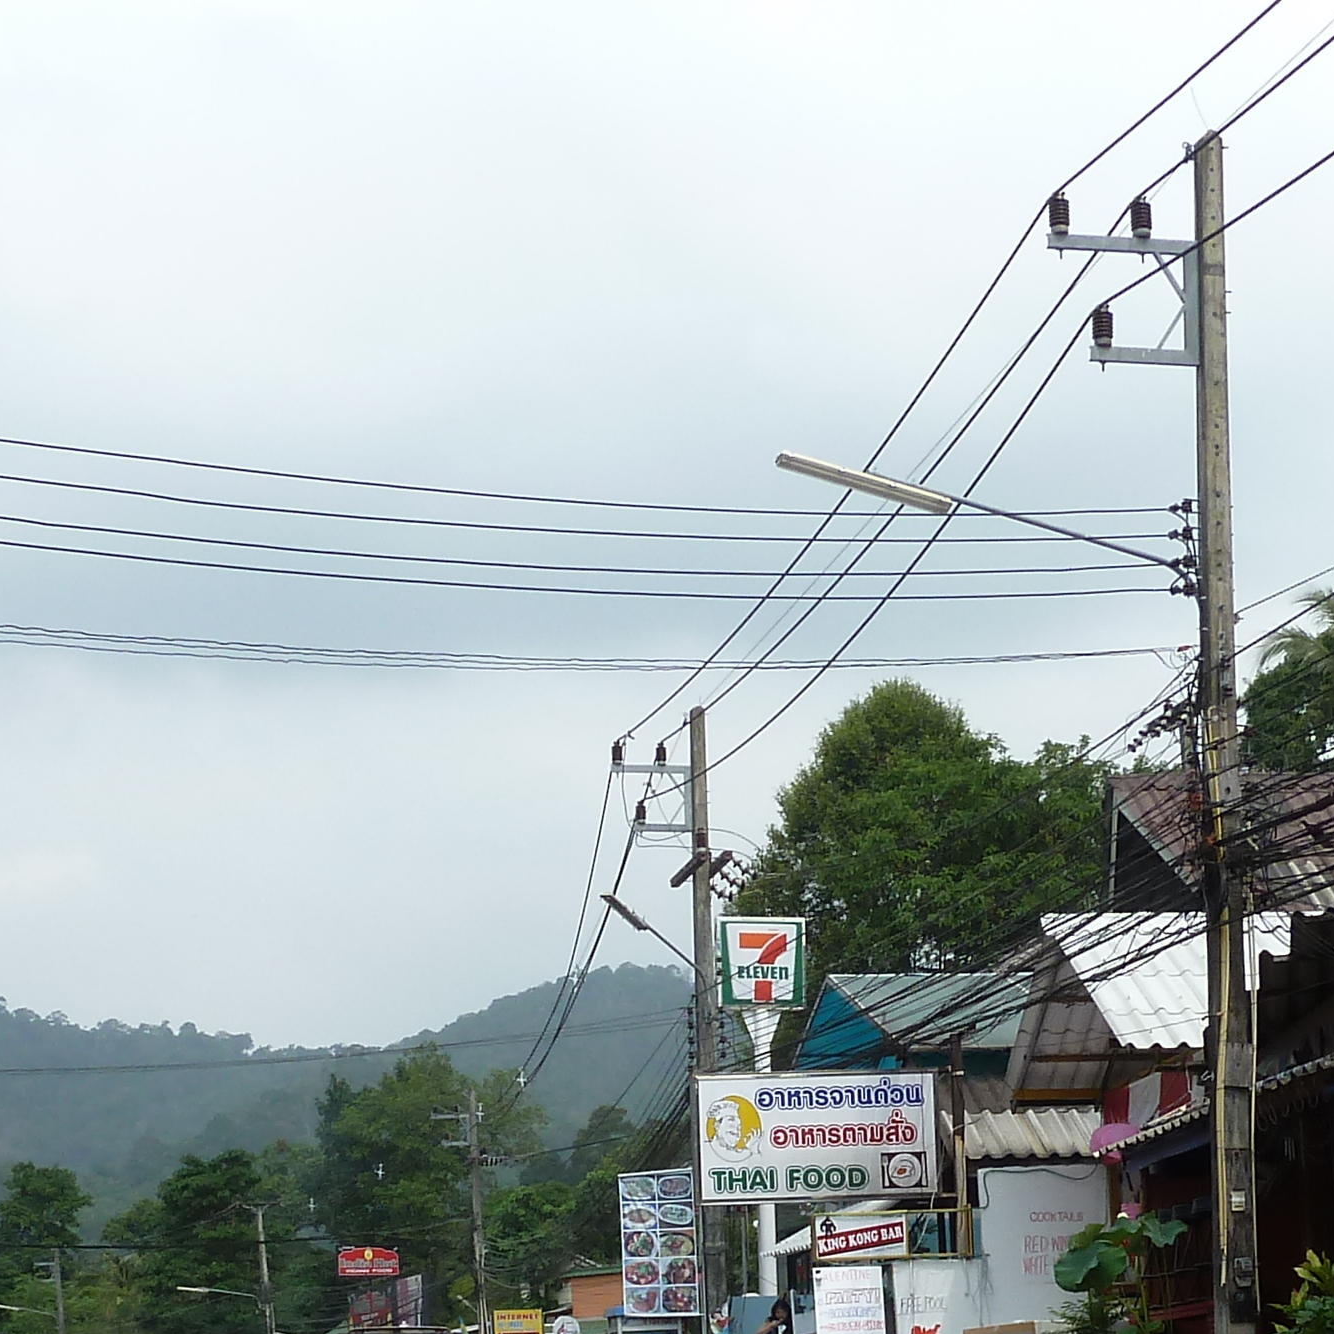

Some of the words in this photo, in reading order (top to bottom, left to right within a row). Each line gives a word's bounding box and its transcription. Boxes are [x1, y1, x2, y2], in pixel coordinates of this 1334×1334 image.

[739, 931, 787, 1002] 7
[755, 1078, 924, 1111] อาหารจานด่วน
[770, 1109, 918, 1149] อาหารตามสั่ง
[709, 1167, 779, 1193] THAI
[786, 1165, 870, 1192] FOOD
[817, 1236, 847, 1254] KING
[848, 1229, 879, 1248] KONG
[880, 1226, 904, 1241] BAR
[1023, 1235, 1050, 1254] RED
[497, 1313, 539, 1321] INTERNET
